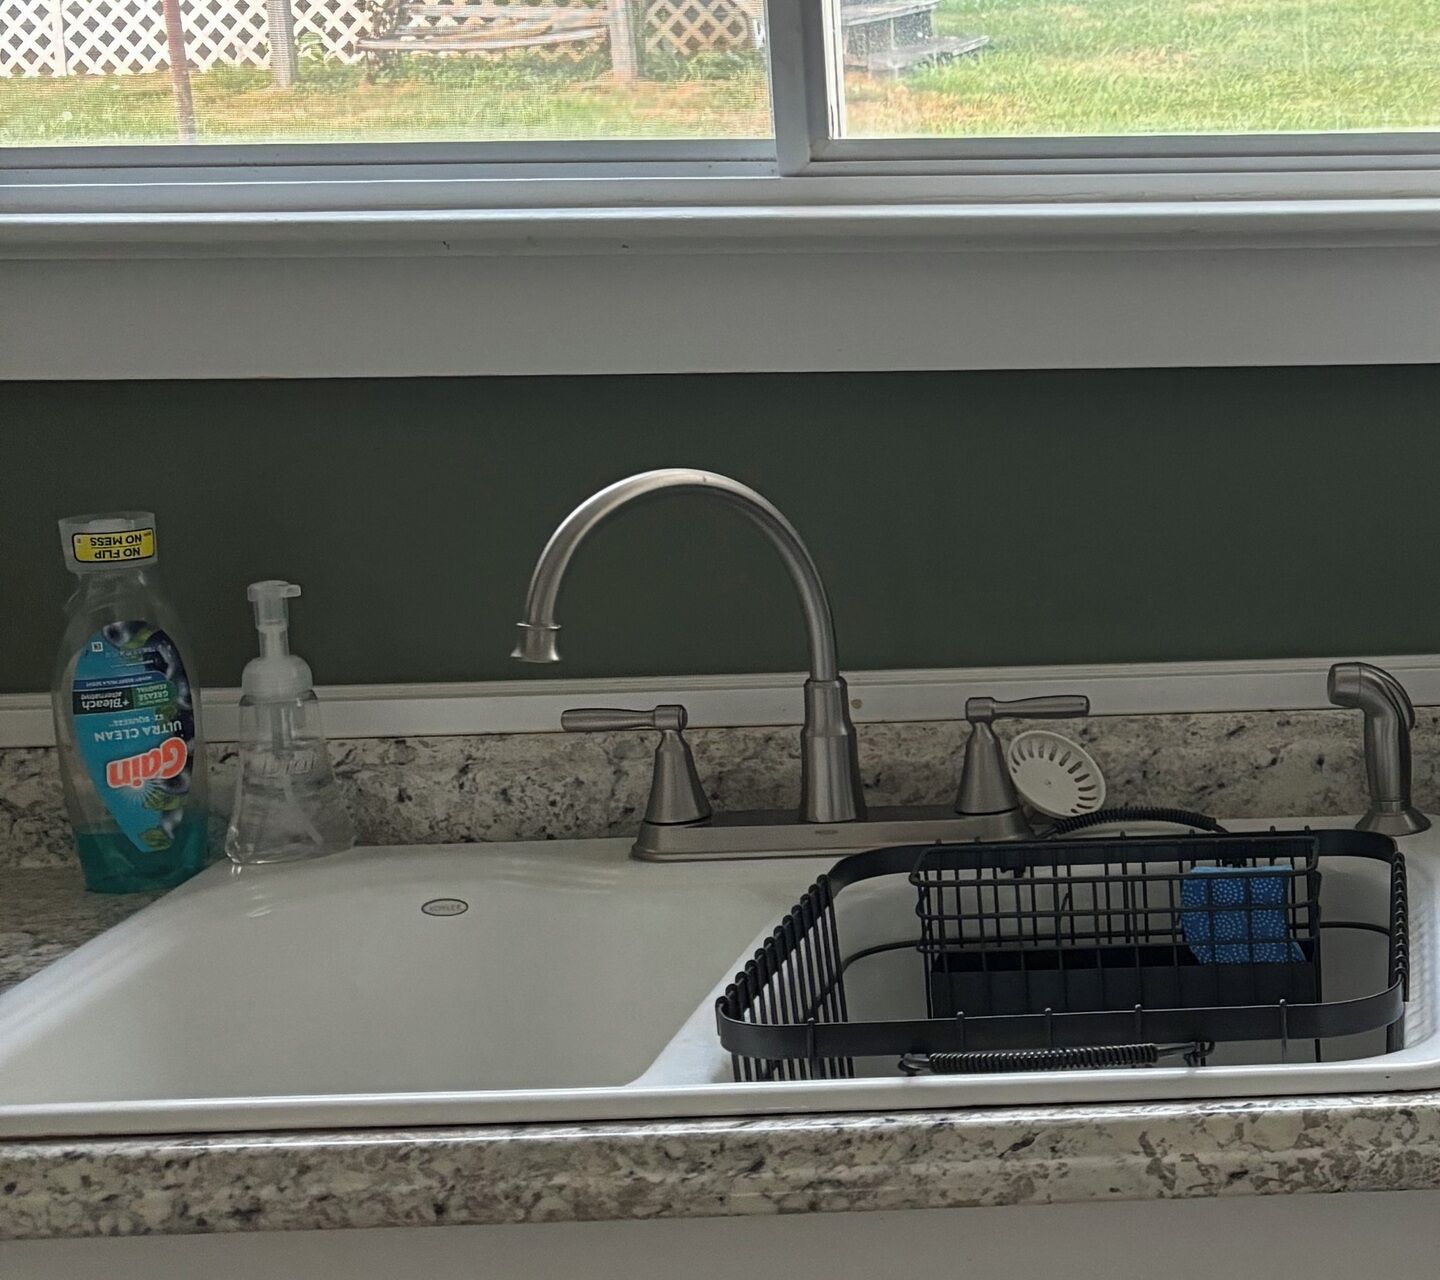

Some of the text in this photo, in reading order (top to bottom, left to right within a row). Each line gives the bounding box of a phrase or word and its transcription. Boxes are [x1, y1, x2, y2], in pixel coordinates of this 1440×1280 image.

[90, 536, 122, 546] MESS
[125, 534, 142, 544] NO
[94, 547, 141, 559] NO FLIP
[94, 720, 182, 742] ULTRA CLEAN
[107, 737, 187, 788] Gain
